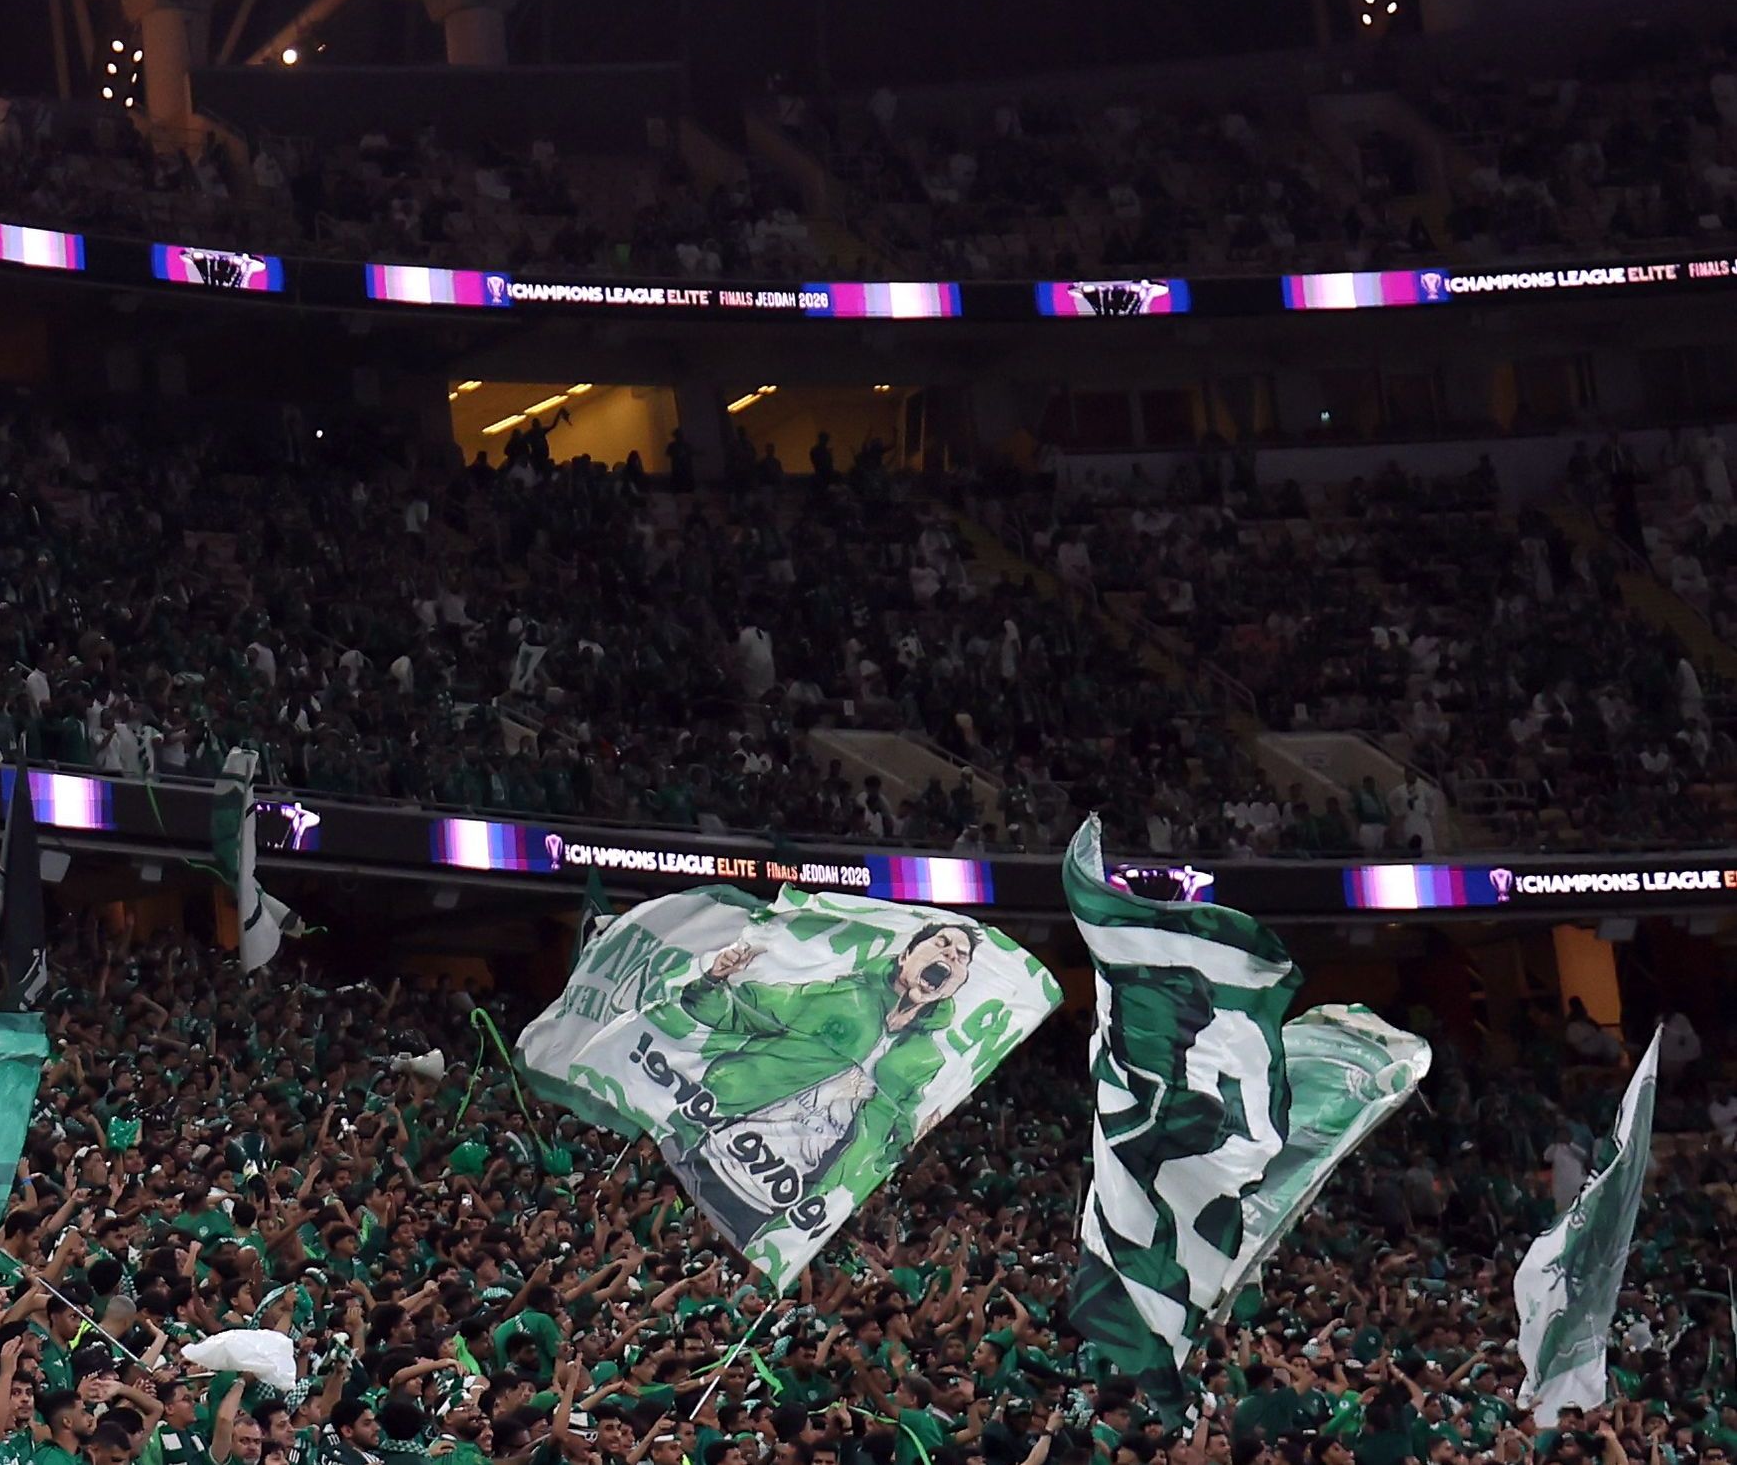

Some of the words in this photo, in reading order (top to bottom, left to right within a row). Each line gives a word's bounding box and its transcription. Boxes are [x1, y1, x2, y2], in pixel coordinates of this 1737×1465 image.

[1451, 271, 1556, 294] CHAMPIONS
[1557, 267, 1626, 287] LEAGUE
[1688, 260, 1729, 278] FINALS
[512, 282, 604, 302] CHAMPIONS
[605, 286, 665, 304] LEAGUE
[719, 290, 754, 306] FINALS
[755, 291, 796, 308] JEDDAH
[798, 292, 829, 308] 2026
[658, 852, 715, 876] LEAGUE
[716, 859, 757, 878] ELITE
[766, 861, 798, 881] FINALS
[799, 864, 839, 884] JEDDAH
[841, 866, 871, 886] 2026
[1522, 873, 1641, 894] CHAMPIONS
[1642, 870, 1722, 891] LEAGUE
